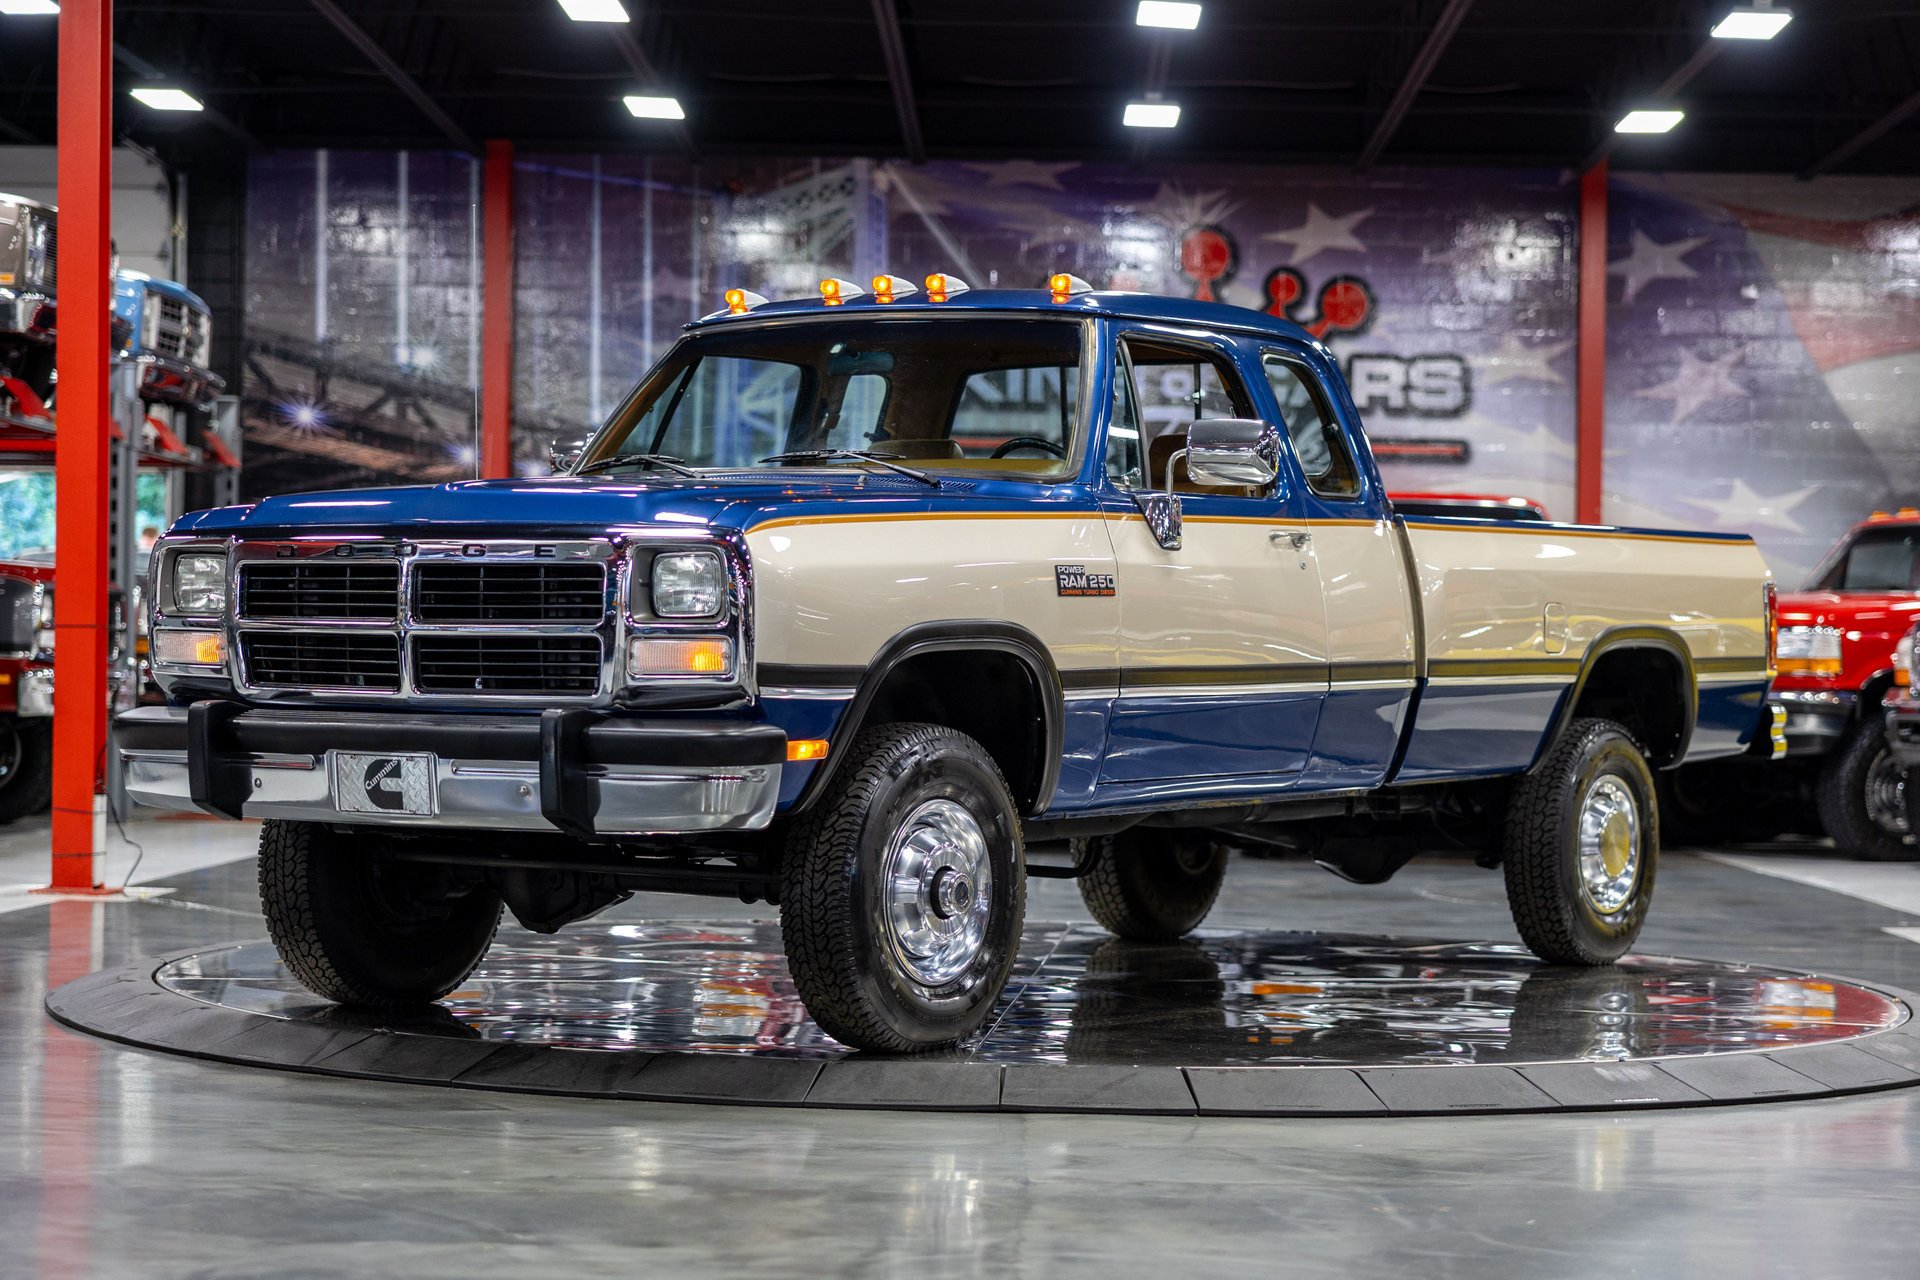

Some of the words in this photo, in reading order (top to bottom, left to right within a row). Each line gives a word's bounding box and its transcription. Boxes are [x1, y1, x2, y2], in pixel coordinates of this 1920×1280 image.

[276, 543, 556, 558] DODGE
[1057, 565, 1085, 574] POWER
[1060, 574, 1088, 588] RAM
[364, 758, 399, 791] Cummins
